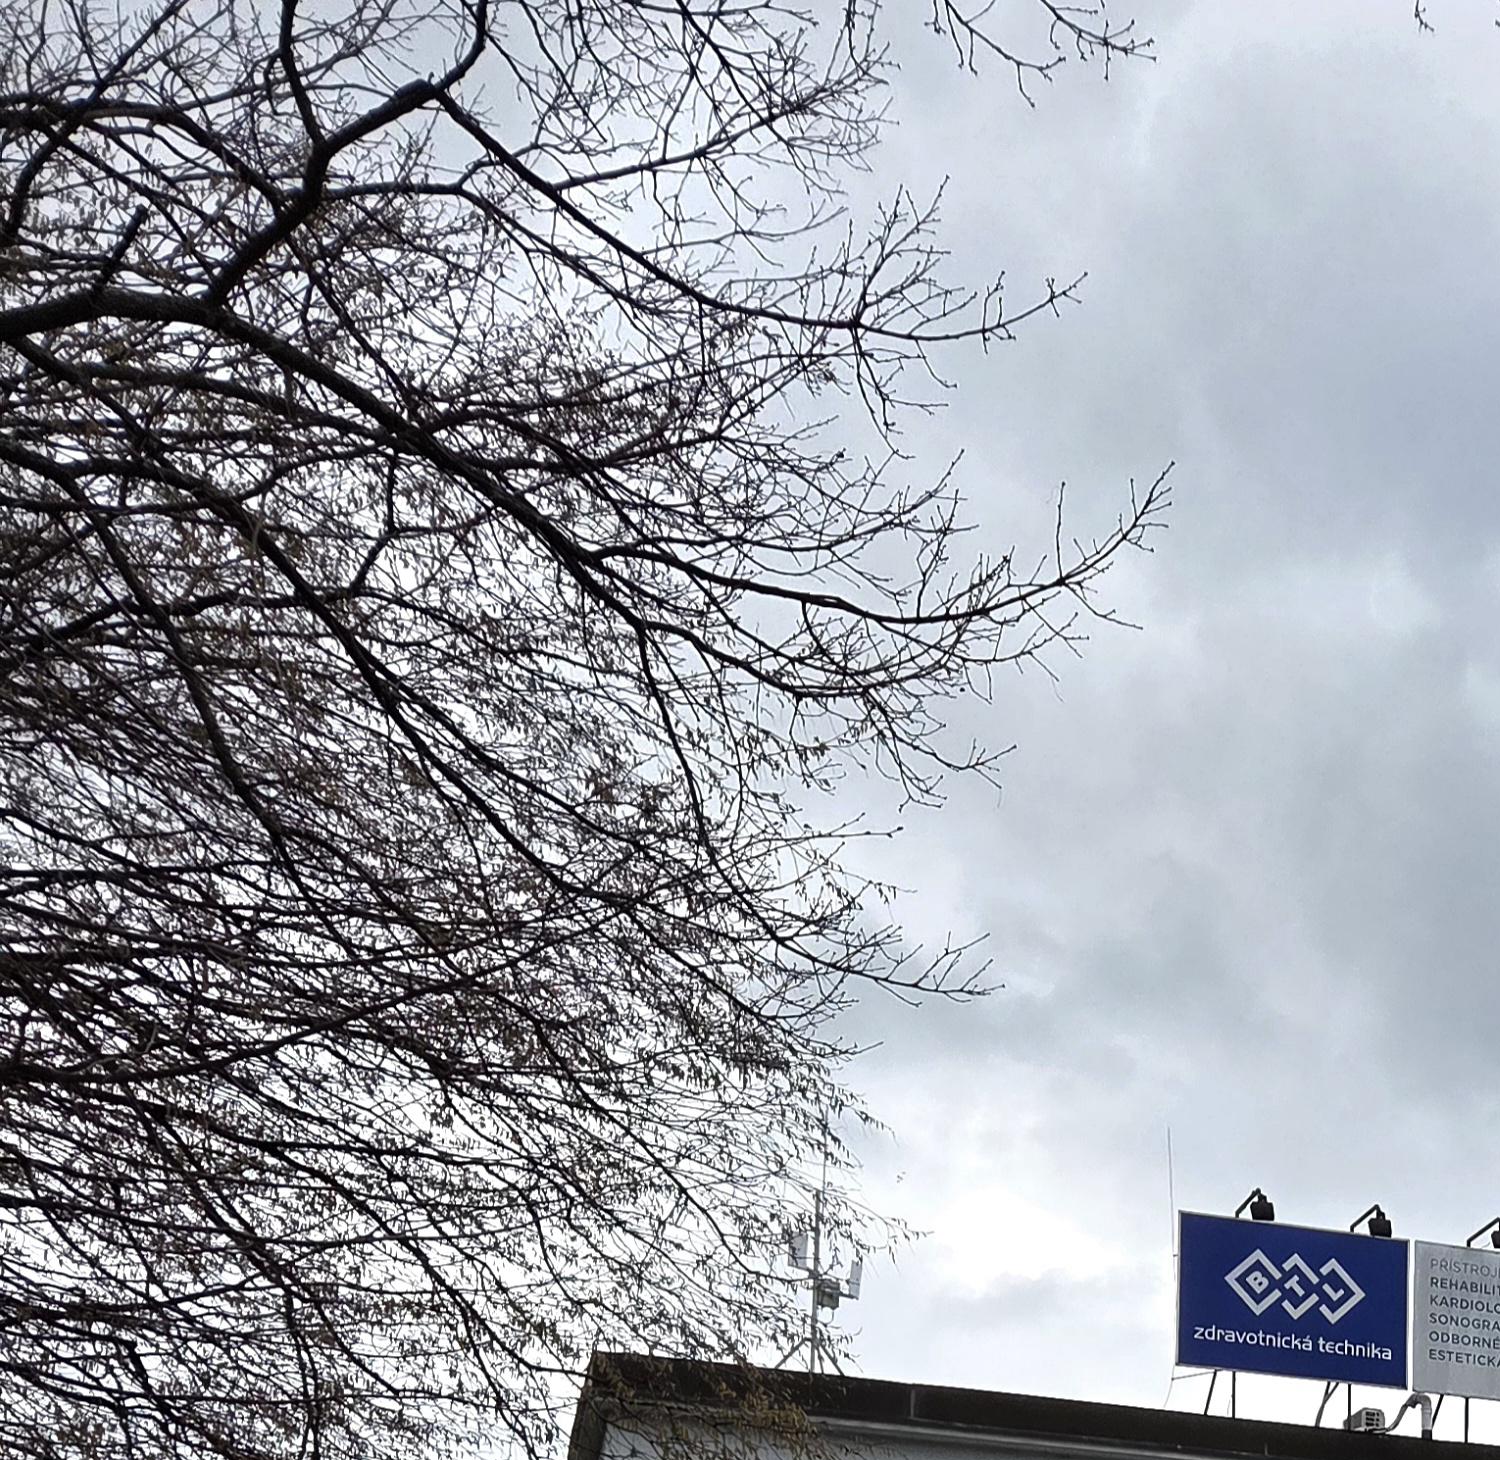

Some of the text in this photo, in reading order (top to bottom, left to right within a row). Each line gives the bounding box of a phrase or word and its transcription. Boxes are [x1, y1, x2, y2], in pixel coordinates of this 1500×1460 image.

[1194, 1325, 1392, 1360] zdravotnická technika
[1429, 1331, 1500, 1350] ODBORNÉ
